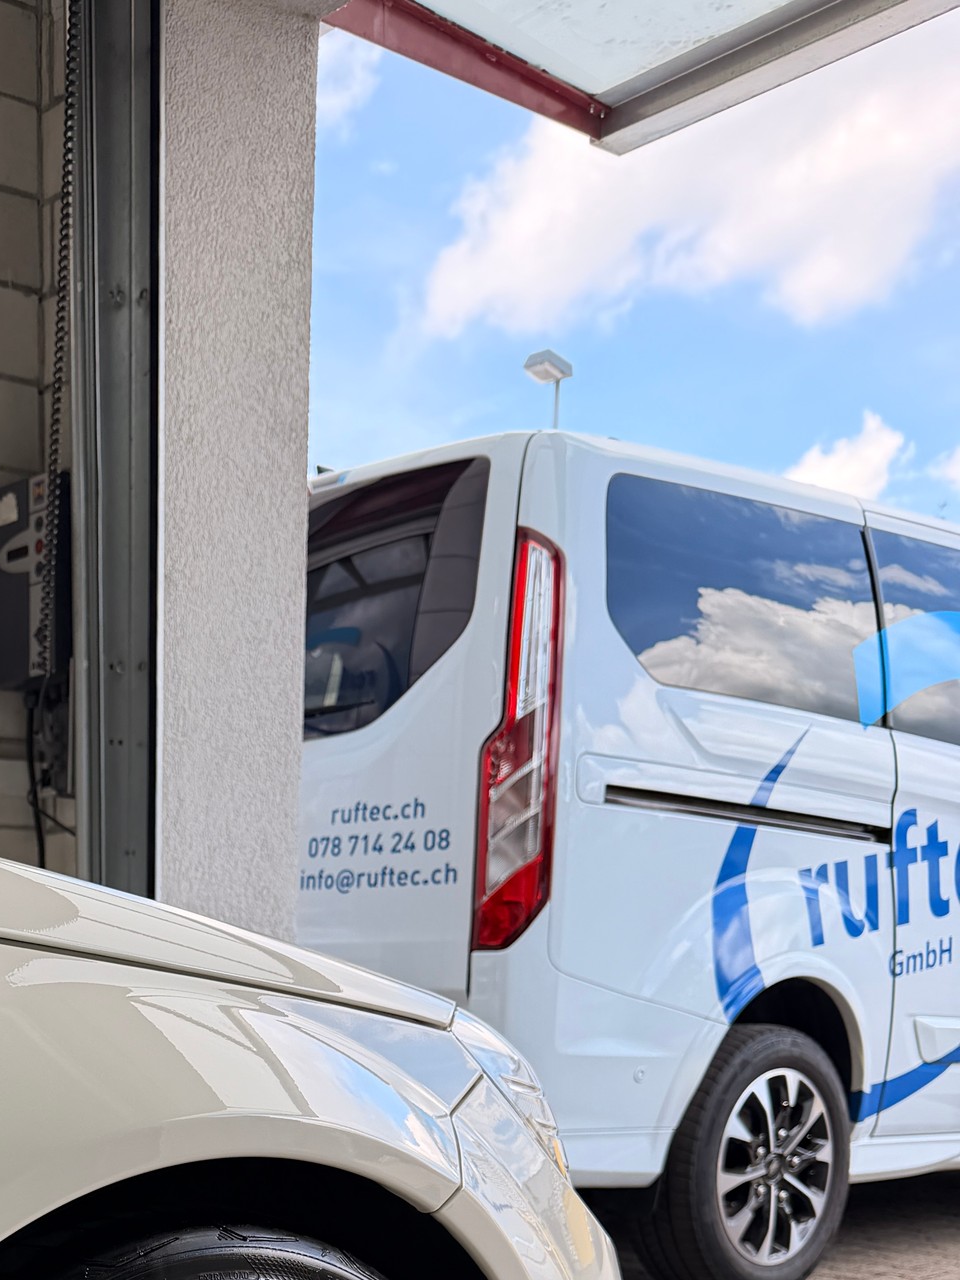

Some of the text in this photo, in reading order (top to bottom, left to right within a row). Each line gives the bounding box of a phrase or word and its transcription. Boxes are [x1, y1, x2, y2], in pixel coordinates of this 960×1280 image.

[330, 798, 427, 826] ruftec.ch
[307, 828, 451, 859] 078 714 24 08
[299, 863, 459, 895] info@ruftec.ch
[798, 807, 960, 948] ruft
[889, 935, 954, 978] GmbH
